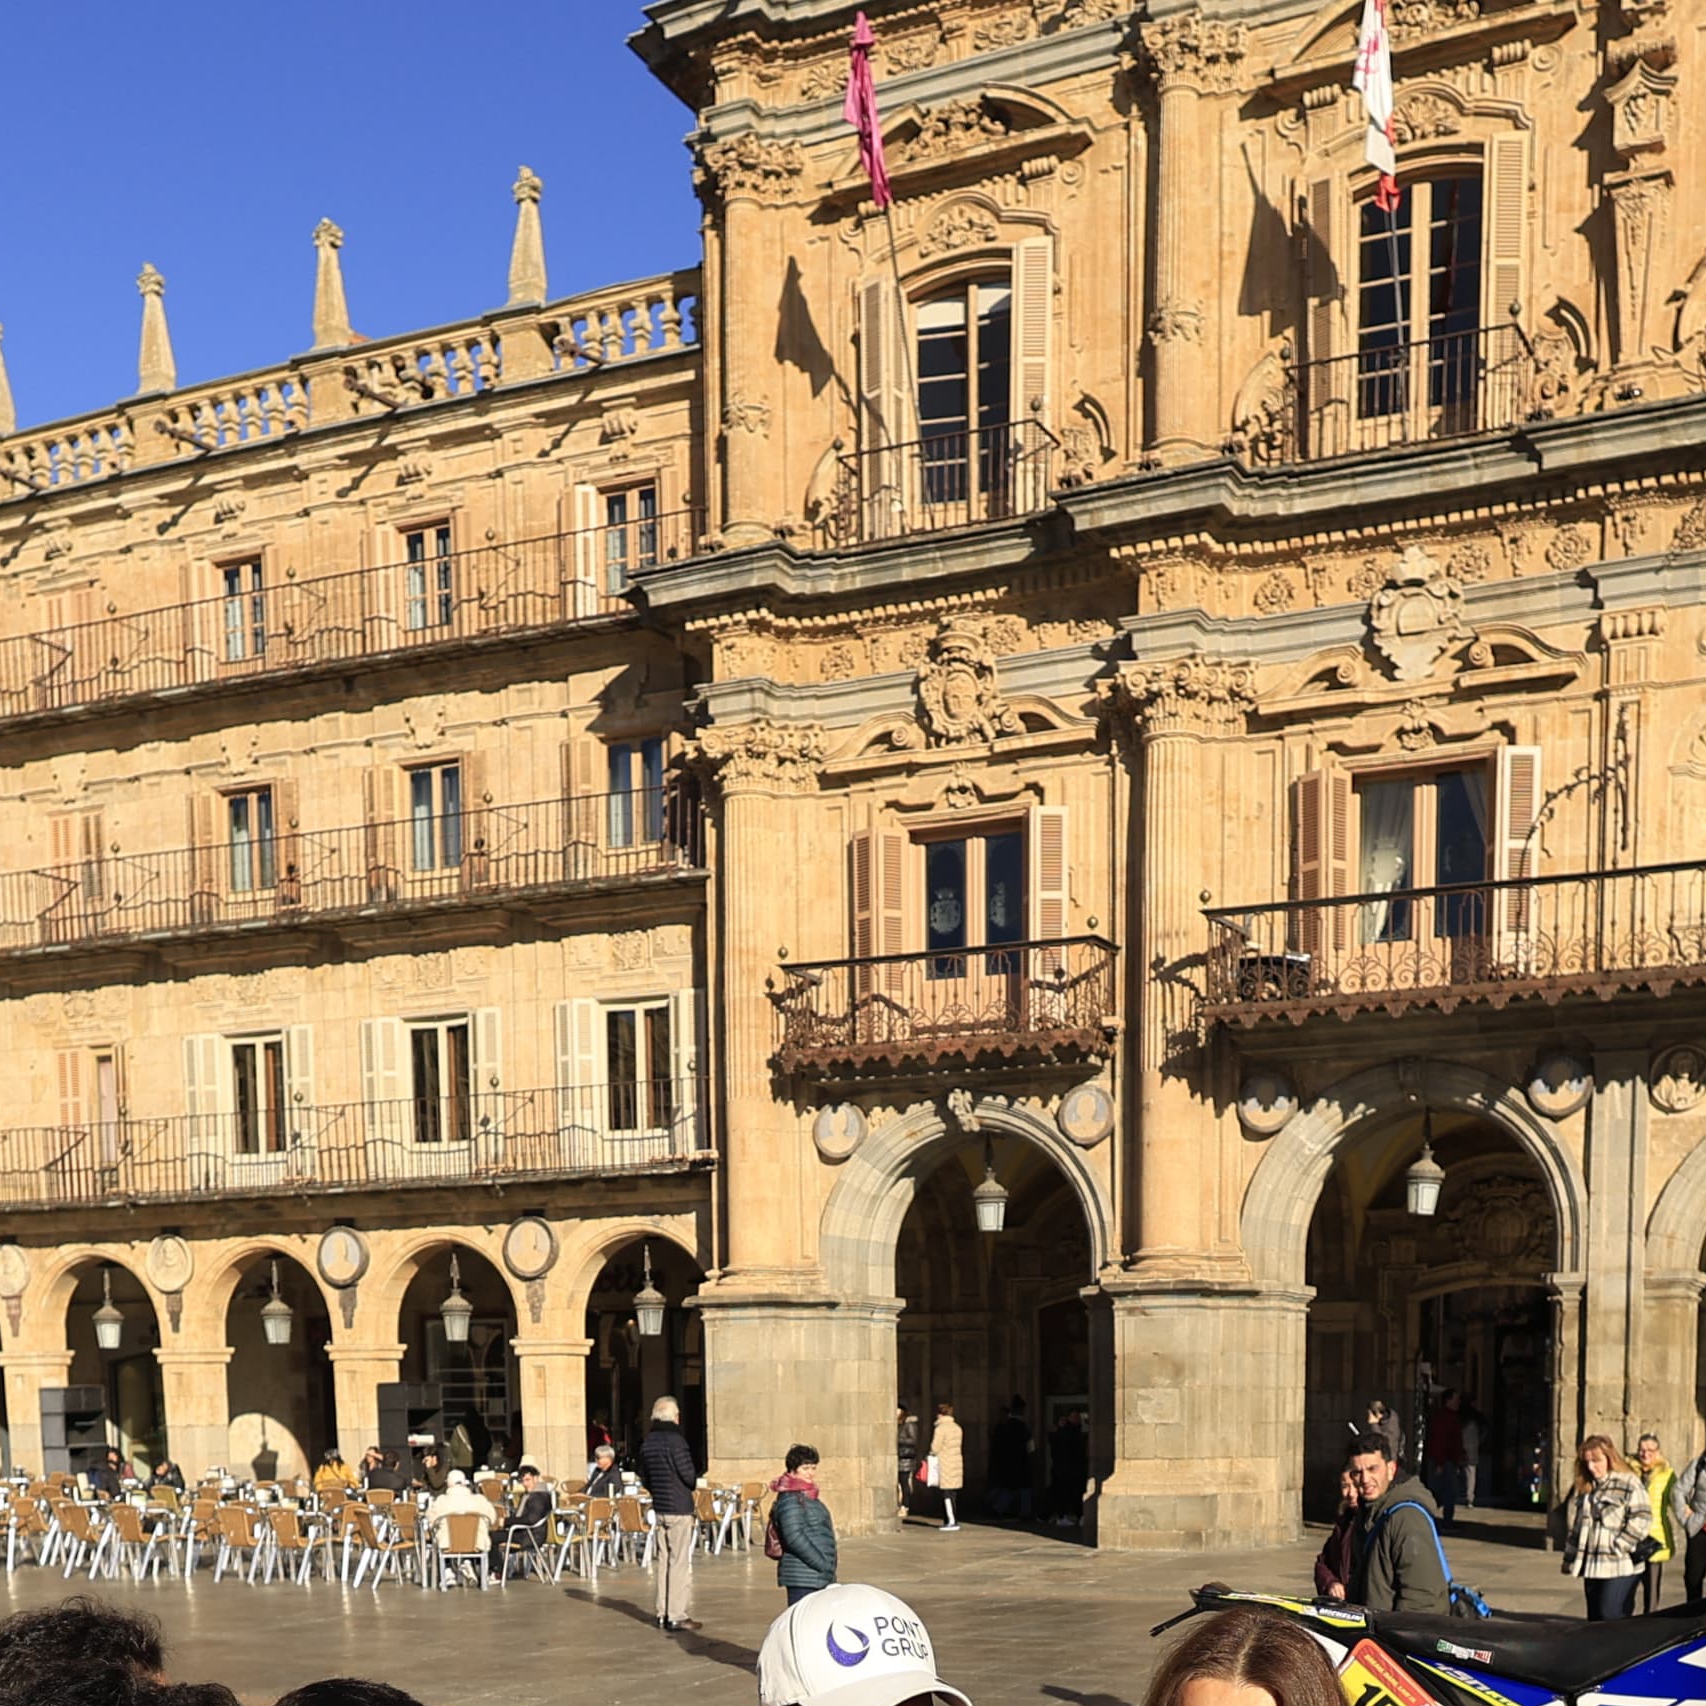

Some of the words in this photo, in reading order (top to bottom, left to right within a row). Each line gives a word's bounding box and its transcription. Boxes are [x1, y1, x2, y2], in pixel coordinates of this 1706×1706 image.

[1318, 1607, 1363, 1621] MICHELIN
[873, 1616, 923, 1642] PONT
[881, 1638, 929, 1660] GRUP
